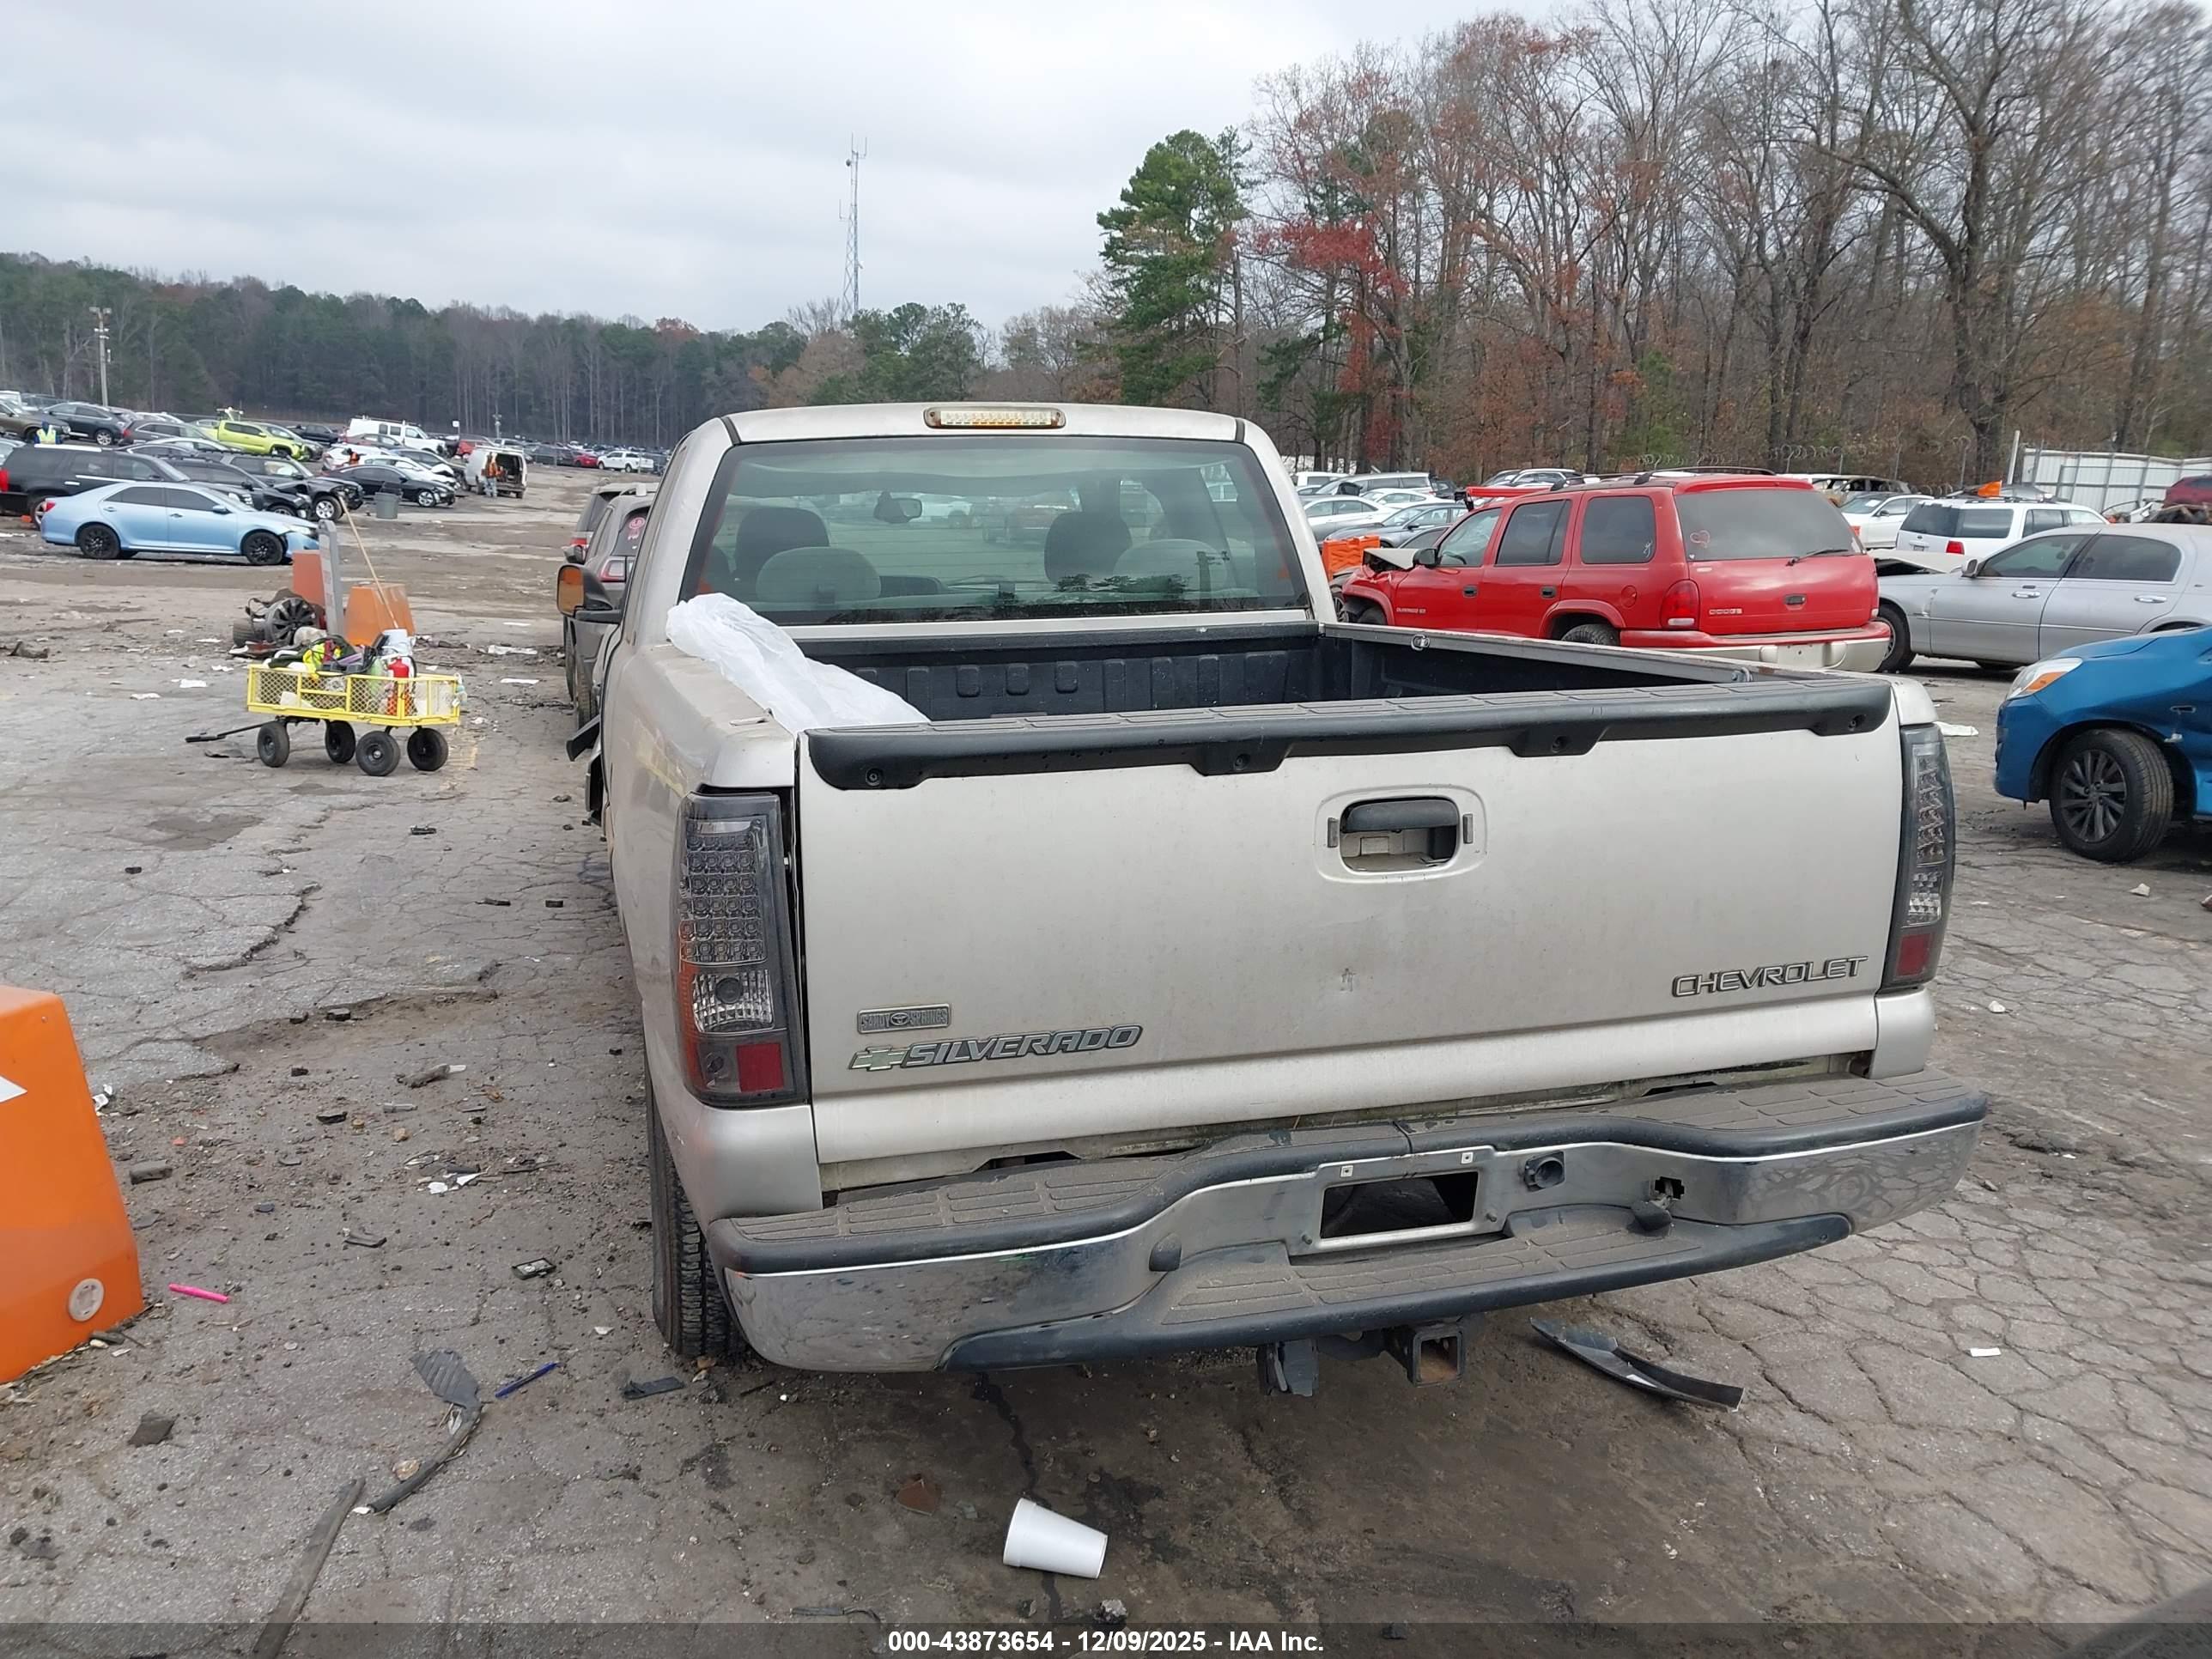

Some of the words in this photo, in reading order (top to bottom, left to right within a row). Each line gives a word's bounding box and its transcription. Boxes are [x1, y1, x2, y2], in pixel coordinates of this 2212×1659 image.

[1673, 956, 1869, 997] CHEVROLET
[860, 1012, 890, 1029] SANDY
[908, 1008, 947, 1025] SPRINGS
[901, 1024, 1143, 1067] SILVERADO
